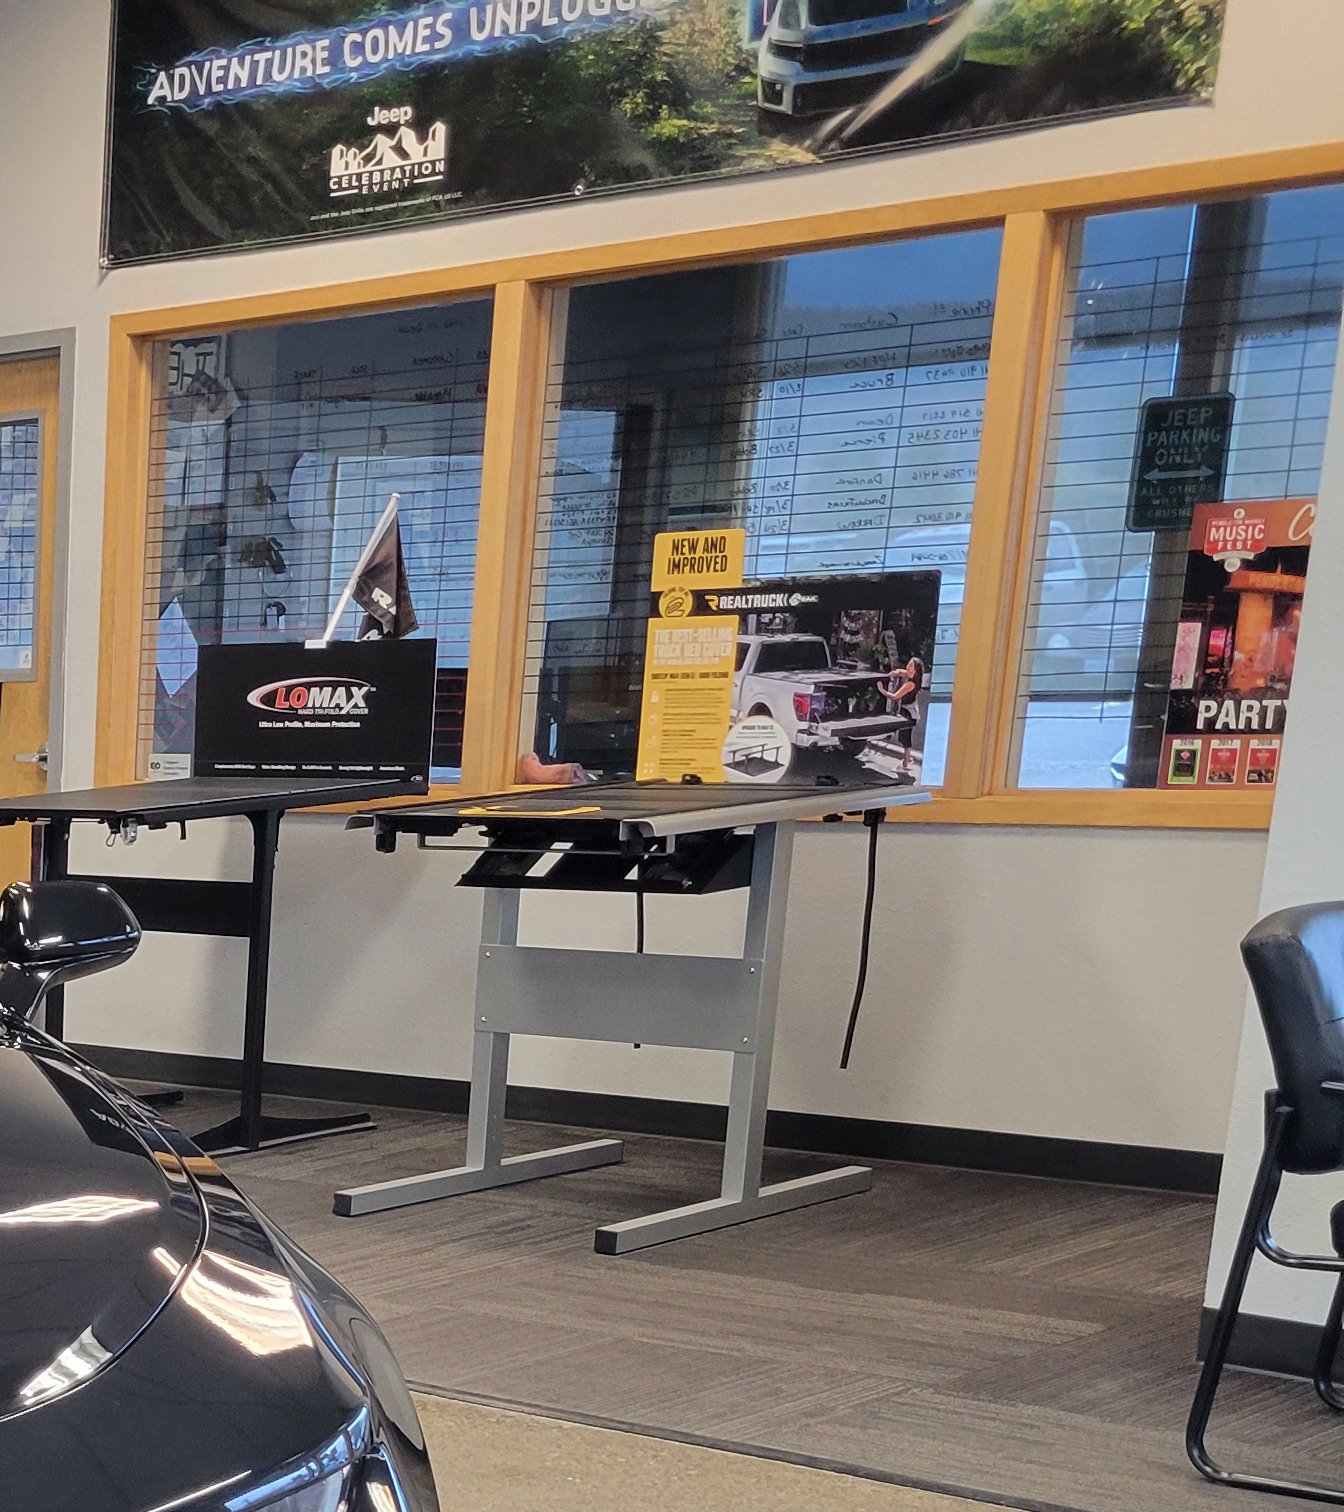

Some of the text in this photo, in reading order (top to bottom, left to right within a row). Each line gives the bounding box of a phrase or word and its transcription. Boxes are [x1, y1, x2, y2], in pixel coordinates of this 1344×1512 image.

[147, 38, 331, 105] ADVENTURE
[344, 12, 453, 68] COMES
[366, 106, 413, 126] Jeep
[329, 160, 445, 190] CELEBRATION
[362, 178, 410, 195] EVENT
[1161, 407, 1213, 427] JEEP
[1147, 427, 1221, 447] PARKING
[1155, 446, 1209, 465] ONLY
[1148, 507, 1192, 518] CRUSHE
[1288, 504, 1317, 541] C
[1209, 525, 1265, 541] MUSIC
[671, 535, 727, 556] NEW AND
[1217, 540, 1253, 550] FEST
[667, 555, 728, 575] IMPROVED
[719, 594, 784, 609] REALTRUCK
[275, 686, 370, 714] LOMAX
